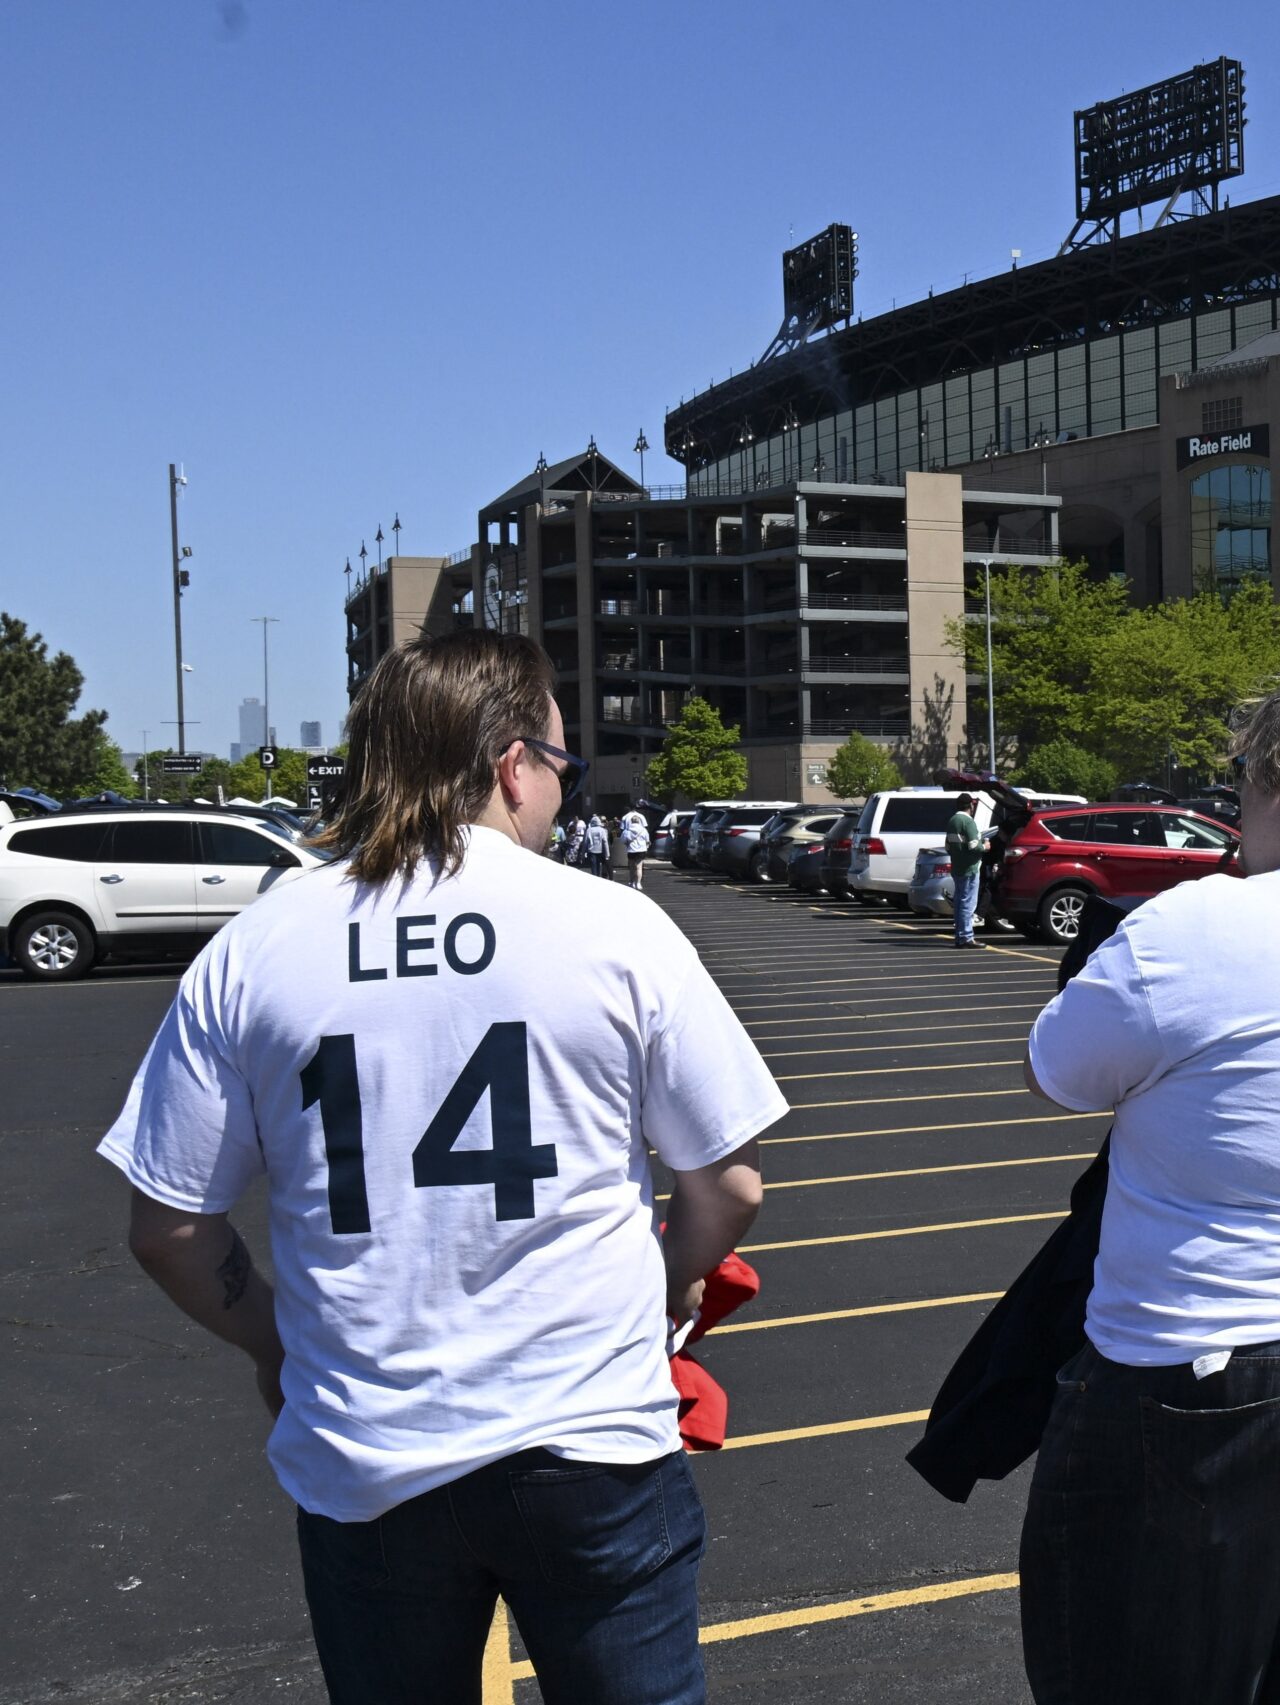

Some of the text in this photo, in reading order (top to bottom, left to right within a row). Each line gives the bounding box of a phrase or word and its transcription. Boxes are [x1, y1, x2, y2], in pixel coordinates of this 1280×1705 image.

[1189, 433, 1251, 457] Rate Field
[262, 752, 275, 764] D
[318, 766, 343, 775] EXIT
[348, 911, 496, 983] LEO
[299, 1020, 559, 1235] 14
